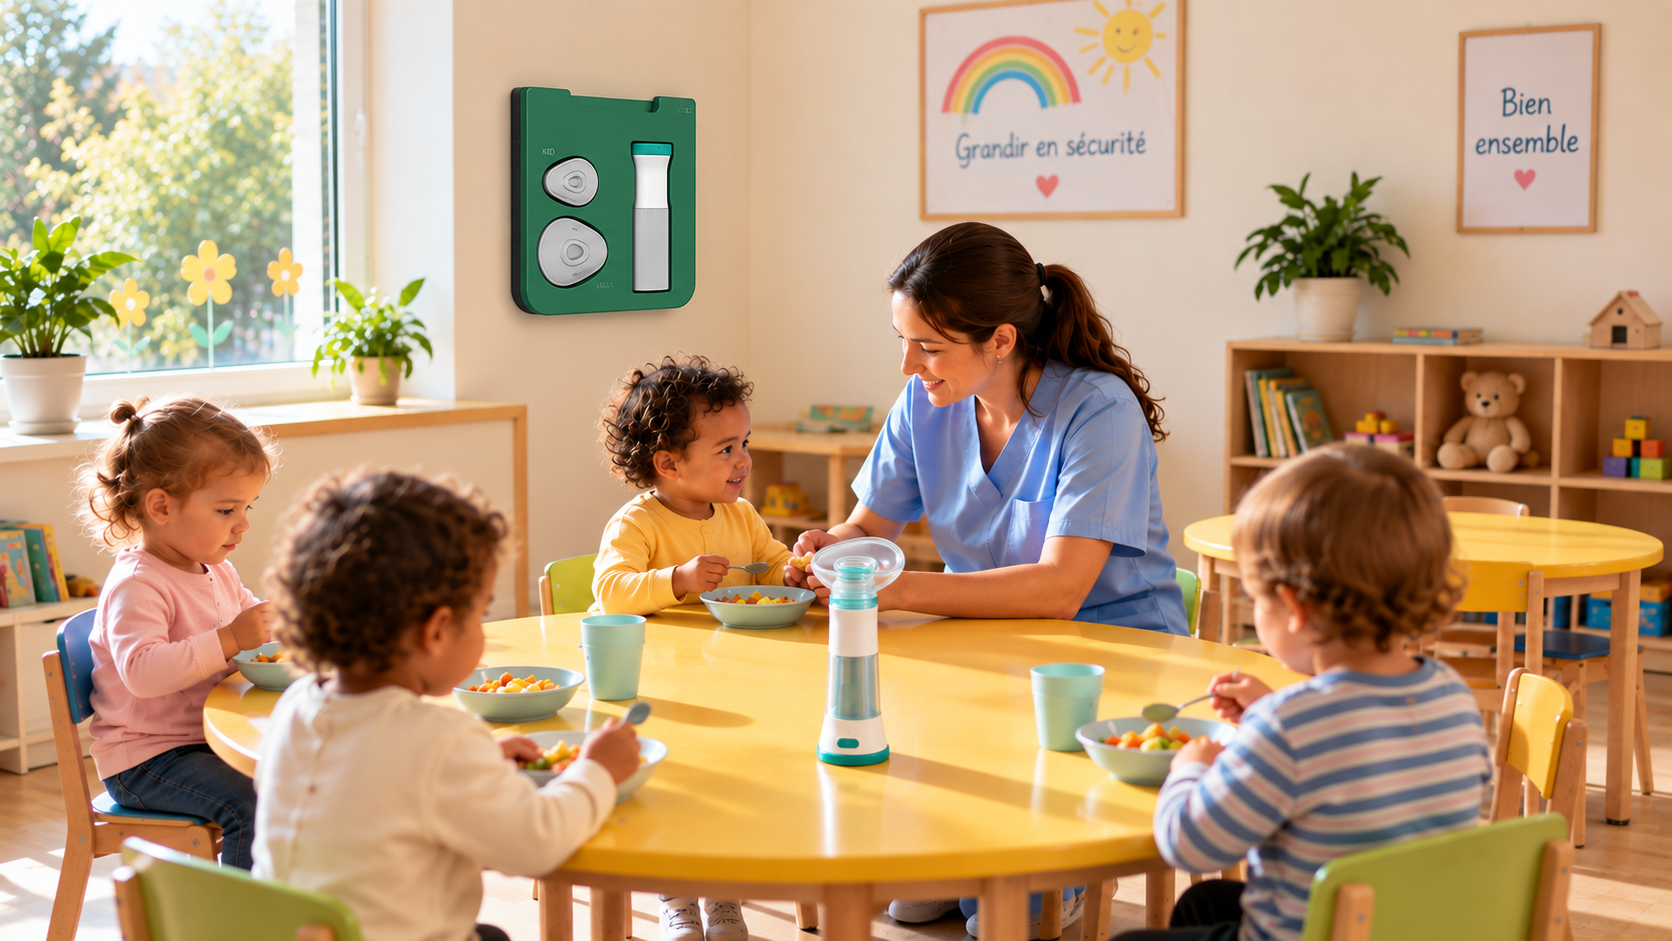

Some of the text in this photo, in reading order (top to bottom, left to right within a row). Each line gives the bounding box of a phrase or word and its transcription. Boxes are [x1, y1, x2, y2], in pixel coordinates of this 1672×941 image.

[1501, 87, 1552, 117] Bien
[956, 131, 1146, 169] Grandir en sécurité
[1475, 123, 1579, 155] ensemble
